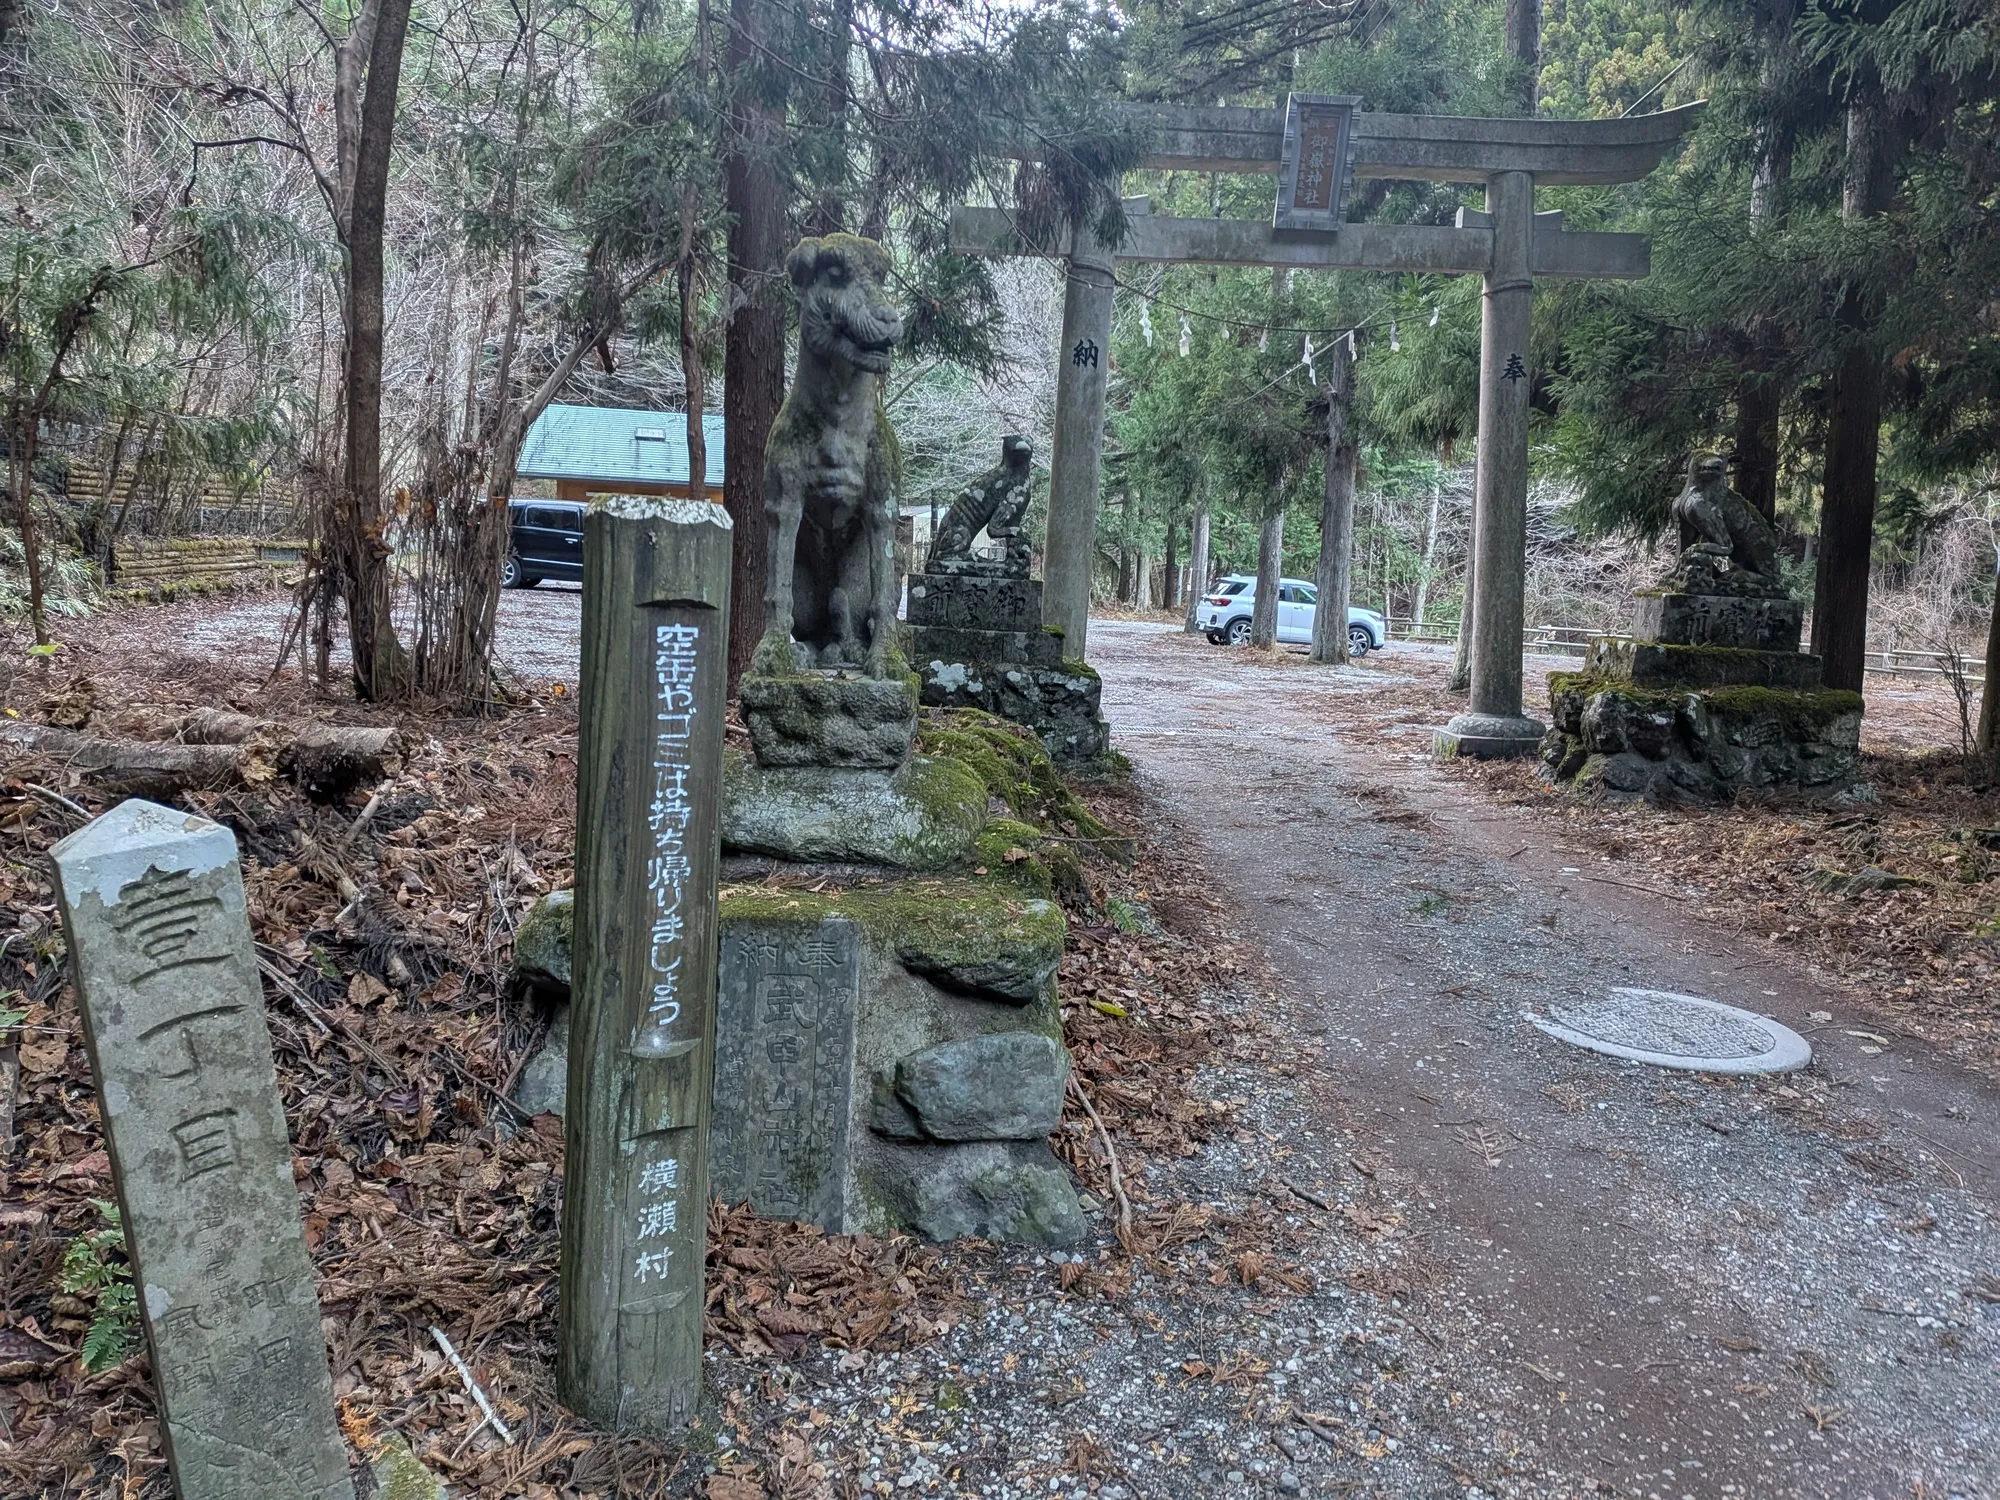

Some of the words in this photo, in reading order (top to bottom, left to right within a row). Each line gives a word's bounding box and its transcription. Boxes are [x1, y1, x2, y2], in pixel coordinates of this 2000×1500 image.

[1073, 339, 1099, 370] 納
[1500, 353, 1527, 385] 奉
[647, 621, 699, 1026] 空缶やゴミは持ち帰りましょう
[751, 983, 816, 1205] 武甲山神社
[633, 1158, 679, 1285] 横瀬村
